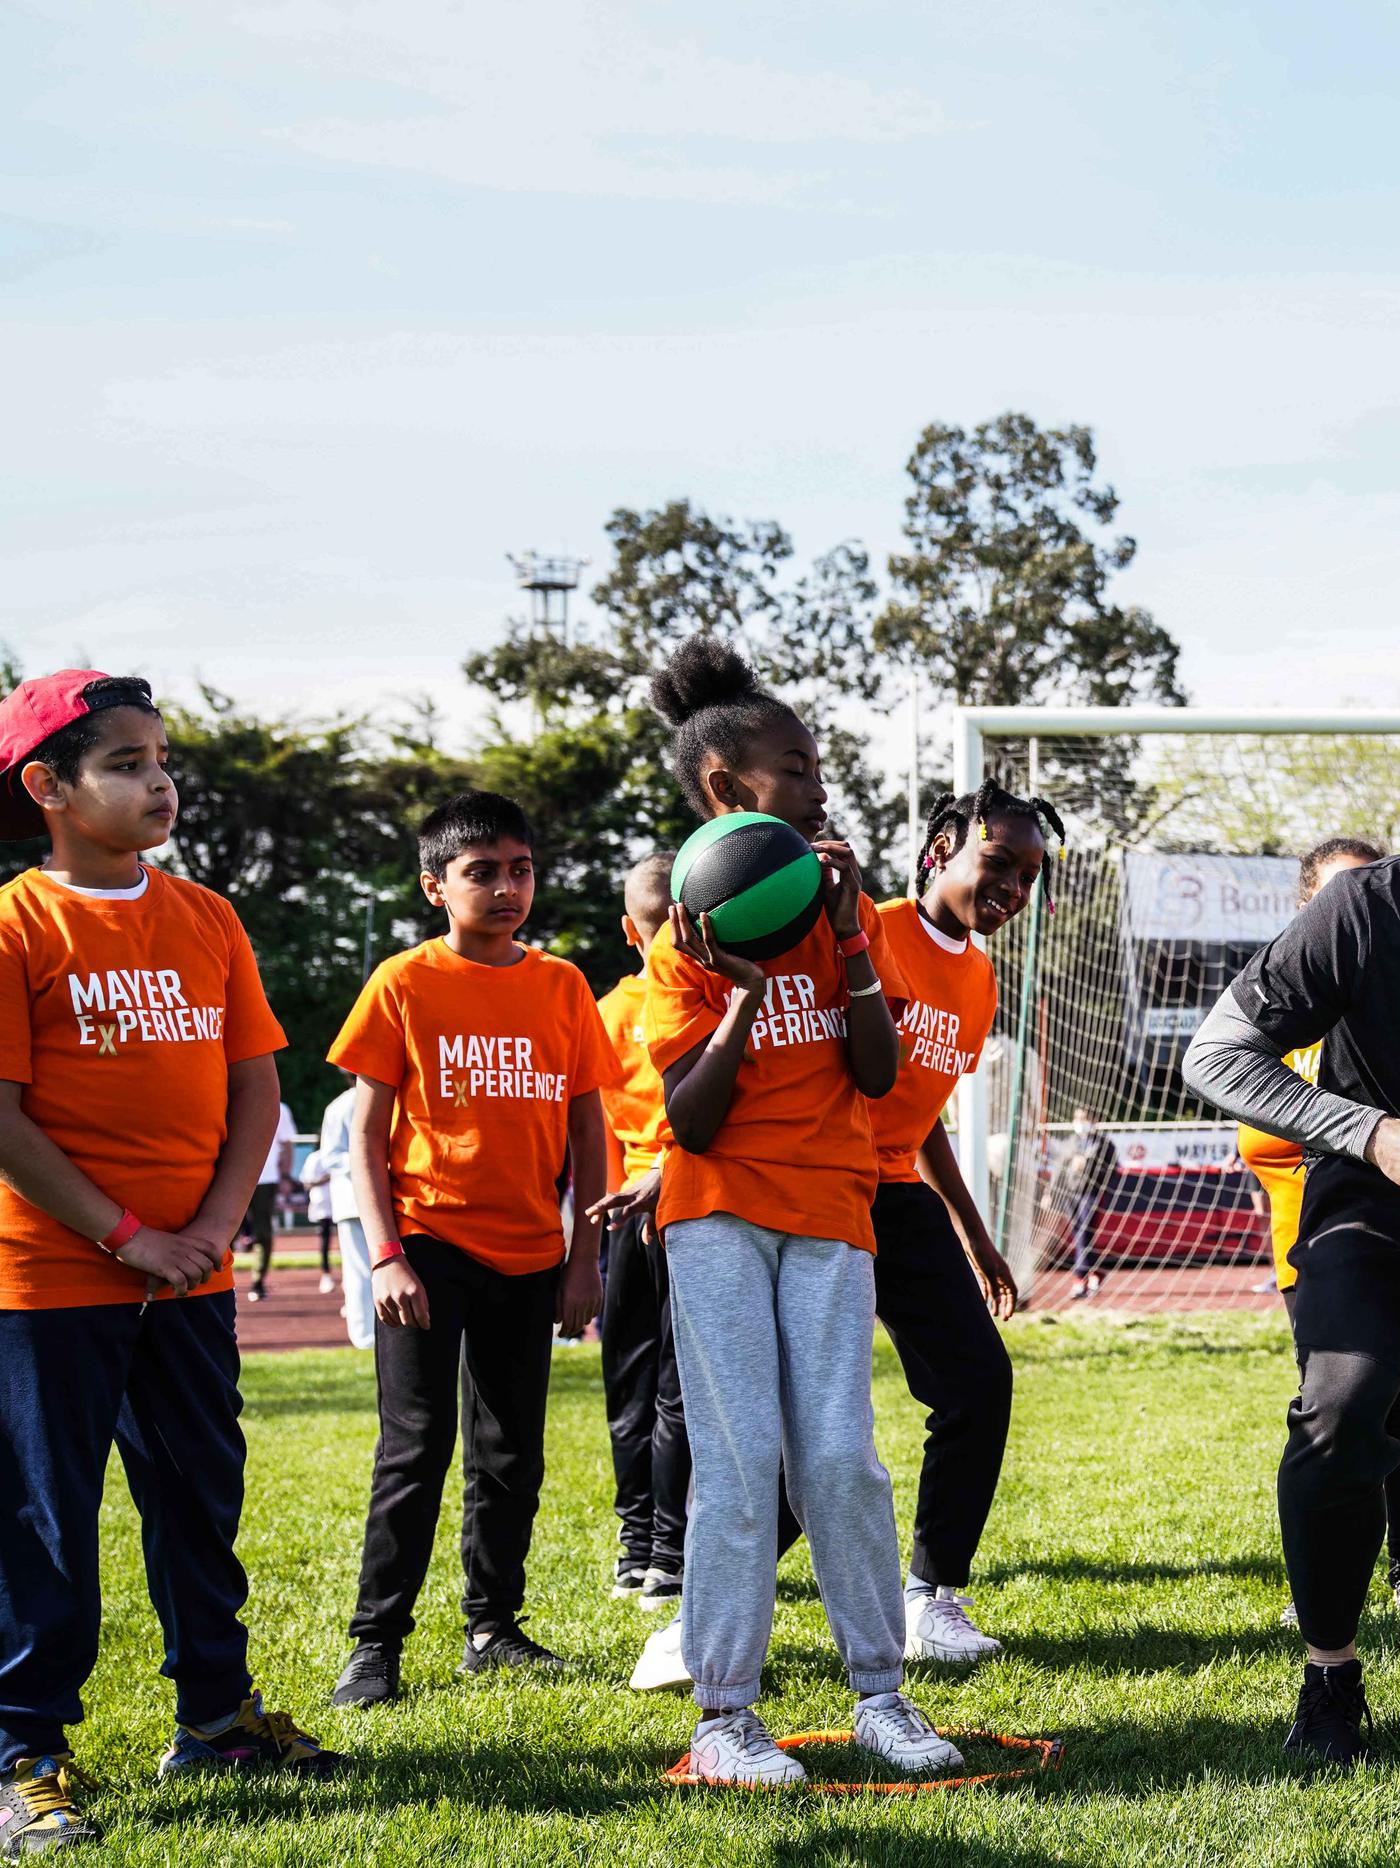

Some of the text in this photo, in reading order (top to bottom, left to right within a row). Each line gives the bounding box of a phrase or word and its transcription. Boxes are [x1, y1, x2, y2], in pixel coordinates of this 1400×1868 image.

[68, 969, 188, 1015] MAYER
[724, 974, 816, 1018] YER
[76, 1006, 225, 1057] EXPERIENCE
[751, 1006, 848, 1050] PERIENC
[897, 1000, 960, 1047] MAYER
[438, 1035, 533, 1070] MAYER
[440, 1069, 567, 1107] EXPERIENCE
